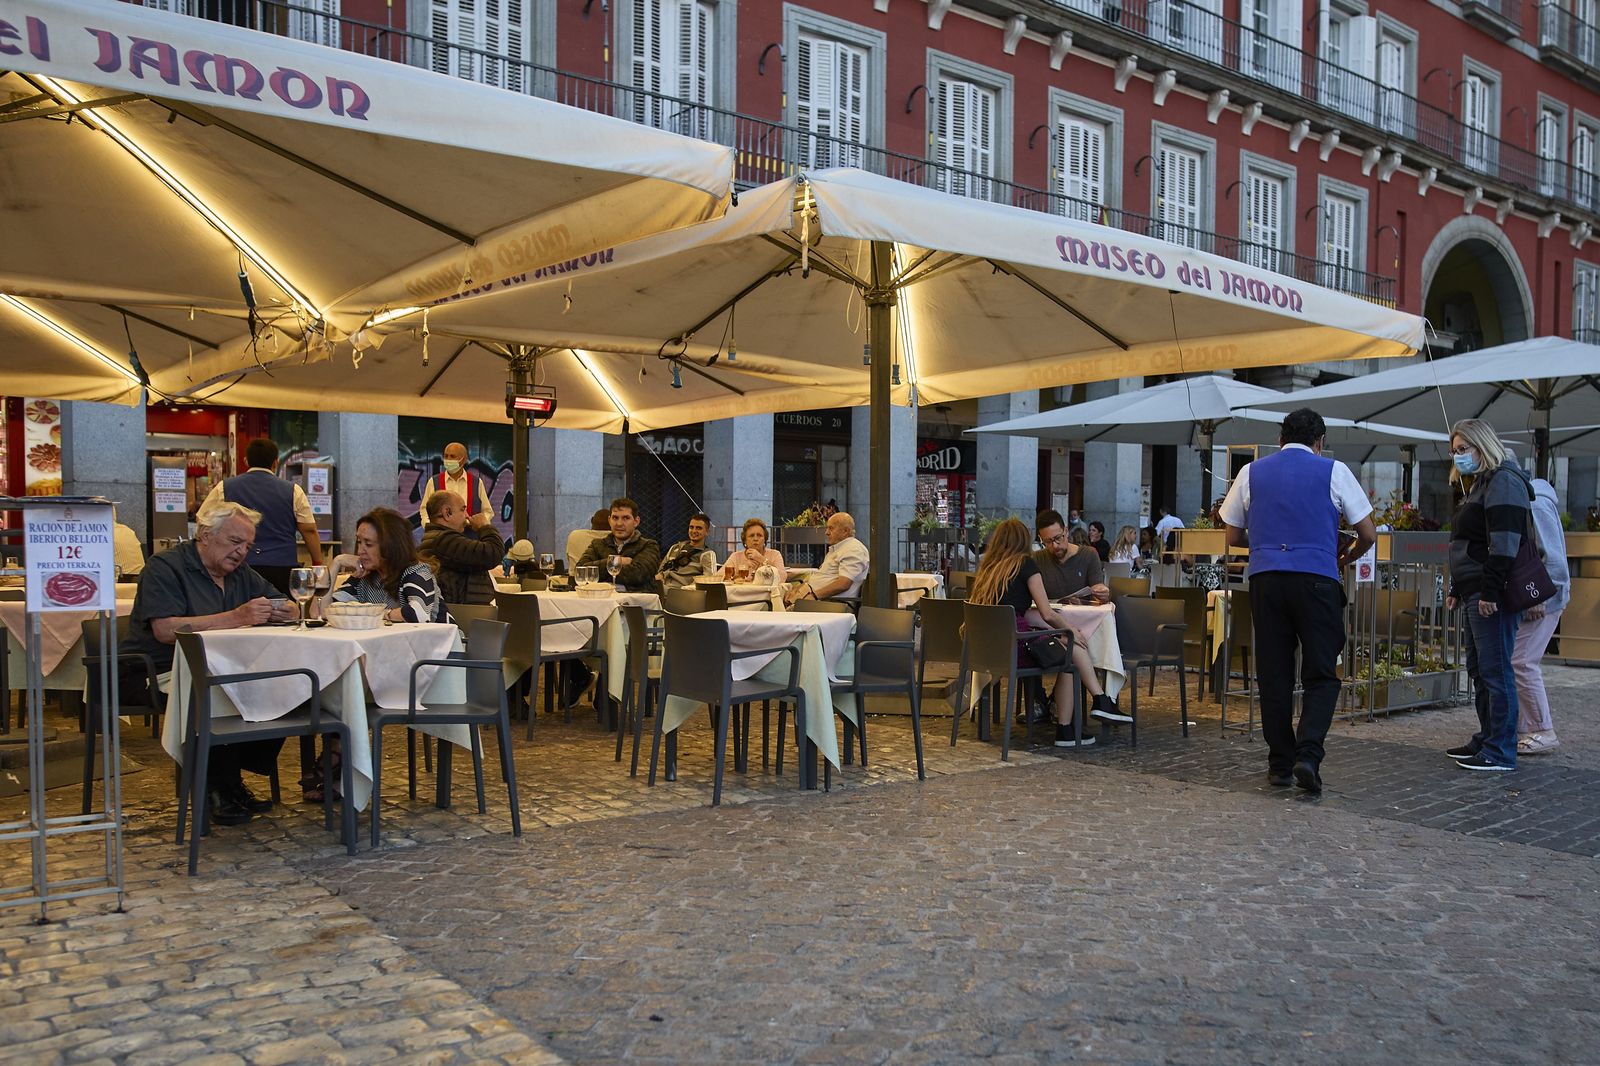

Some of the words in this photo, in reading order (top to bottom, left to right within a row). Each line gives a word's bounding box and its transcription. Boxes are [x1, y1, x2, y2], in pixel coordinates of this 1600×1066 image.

[84, 27, 371, 121] JAMON
[1055, 235, 1166, 279] MUSEO
[1177, 261, 1212, 291] del
[1219, 269, 1303, 313] JAMON
[775, 413, 822, 426] CUERDOS
[28, 522, 63, 533] RACION
[65, 522, 78, 533] DE
[78, 522, 108, 533] JAMON
[29, 534, 67, 544] IBERICO
[69, 534, 109, 544] BELLOTA
[57, 545, 83, 559] 12€
[36, 561, 66, 569] PRECIO
[67, 561, 101, 569] TERRAZA
